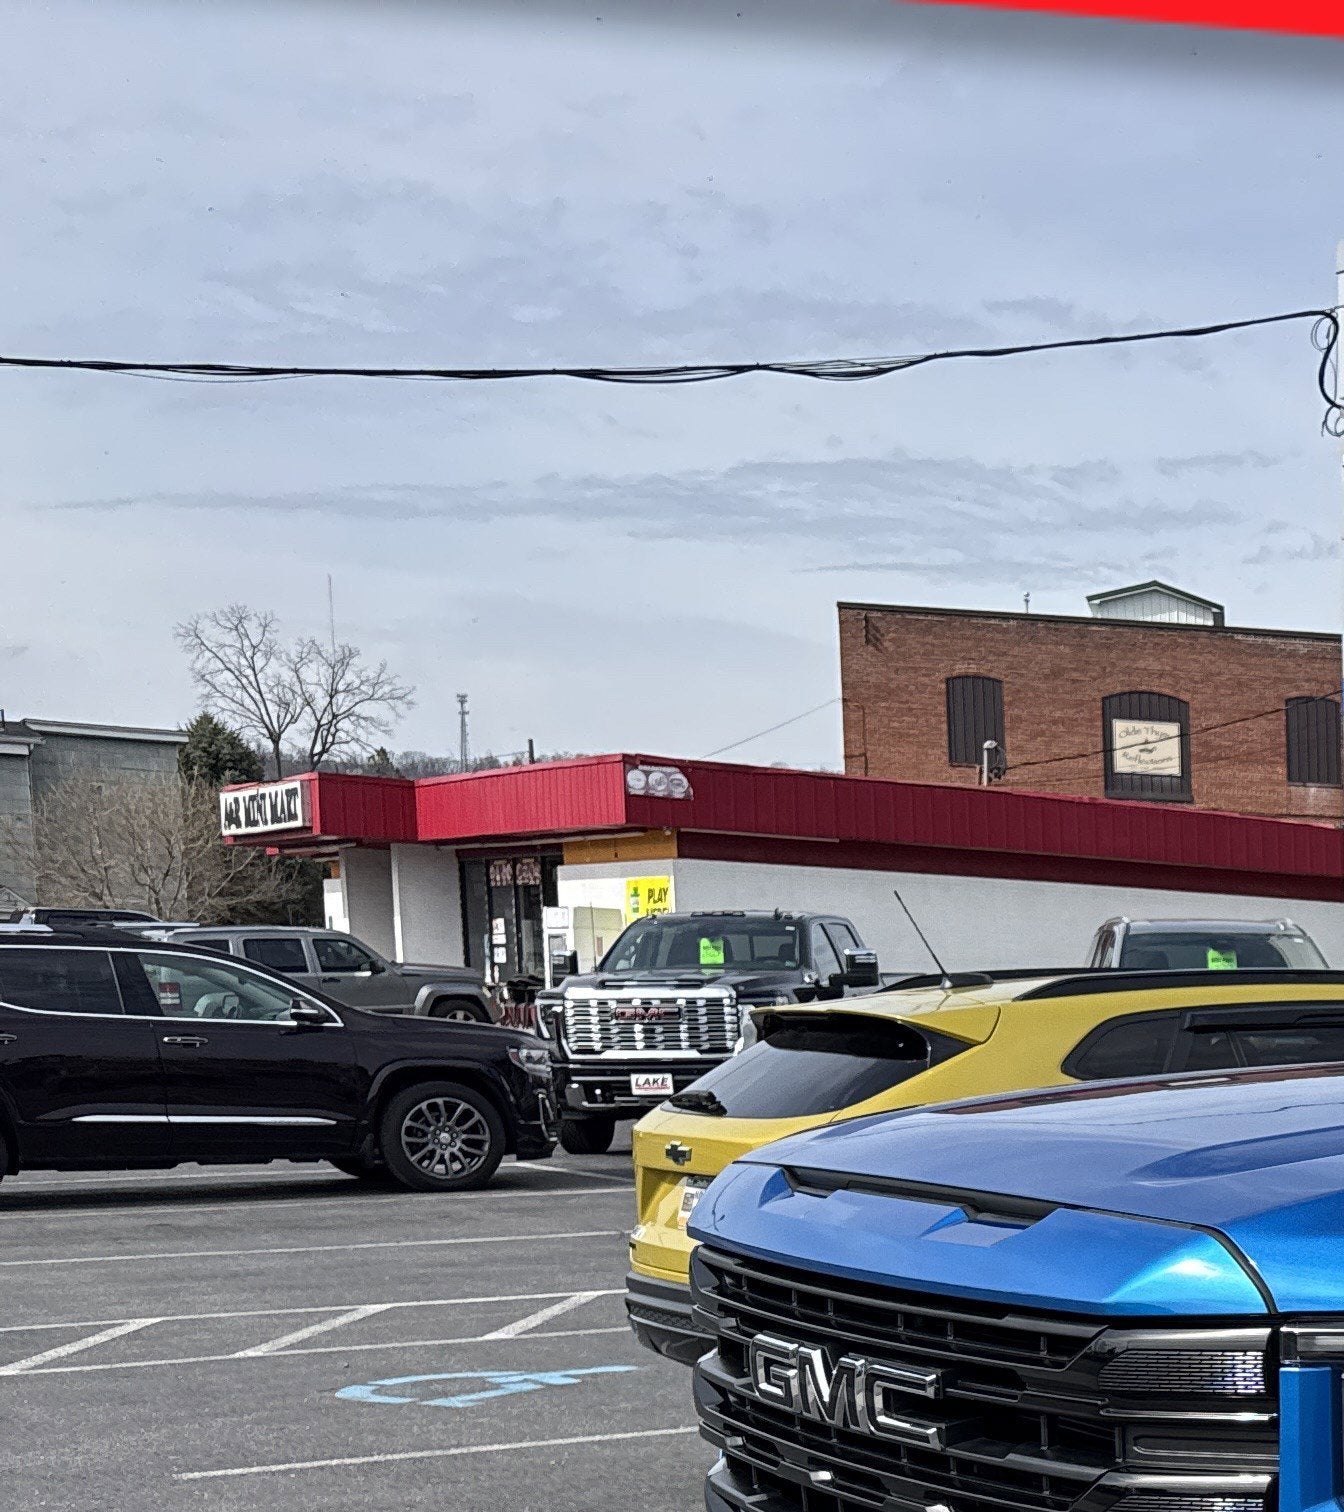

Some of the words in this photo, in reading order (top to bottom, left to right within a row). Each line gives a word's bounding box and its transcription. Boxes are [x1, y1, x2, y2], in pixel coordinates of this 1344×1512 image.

[647, 886, 669, 904] PLAY
[615, 1006, 680, 1021] GMC
[634, 1076, 669, 1087] LAKE
[749, 1332, 948, 1452] GMC
